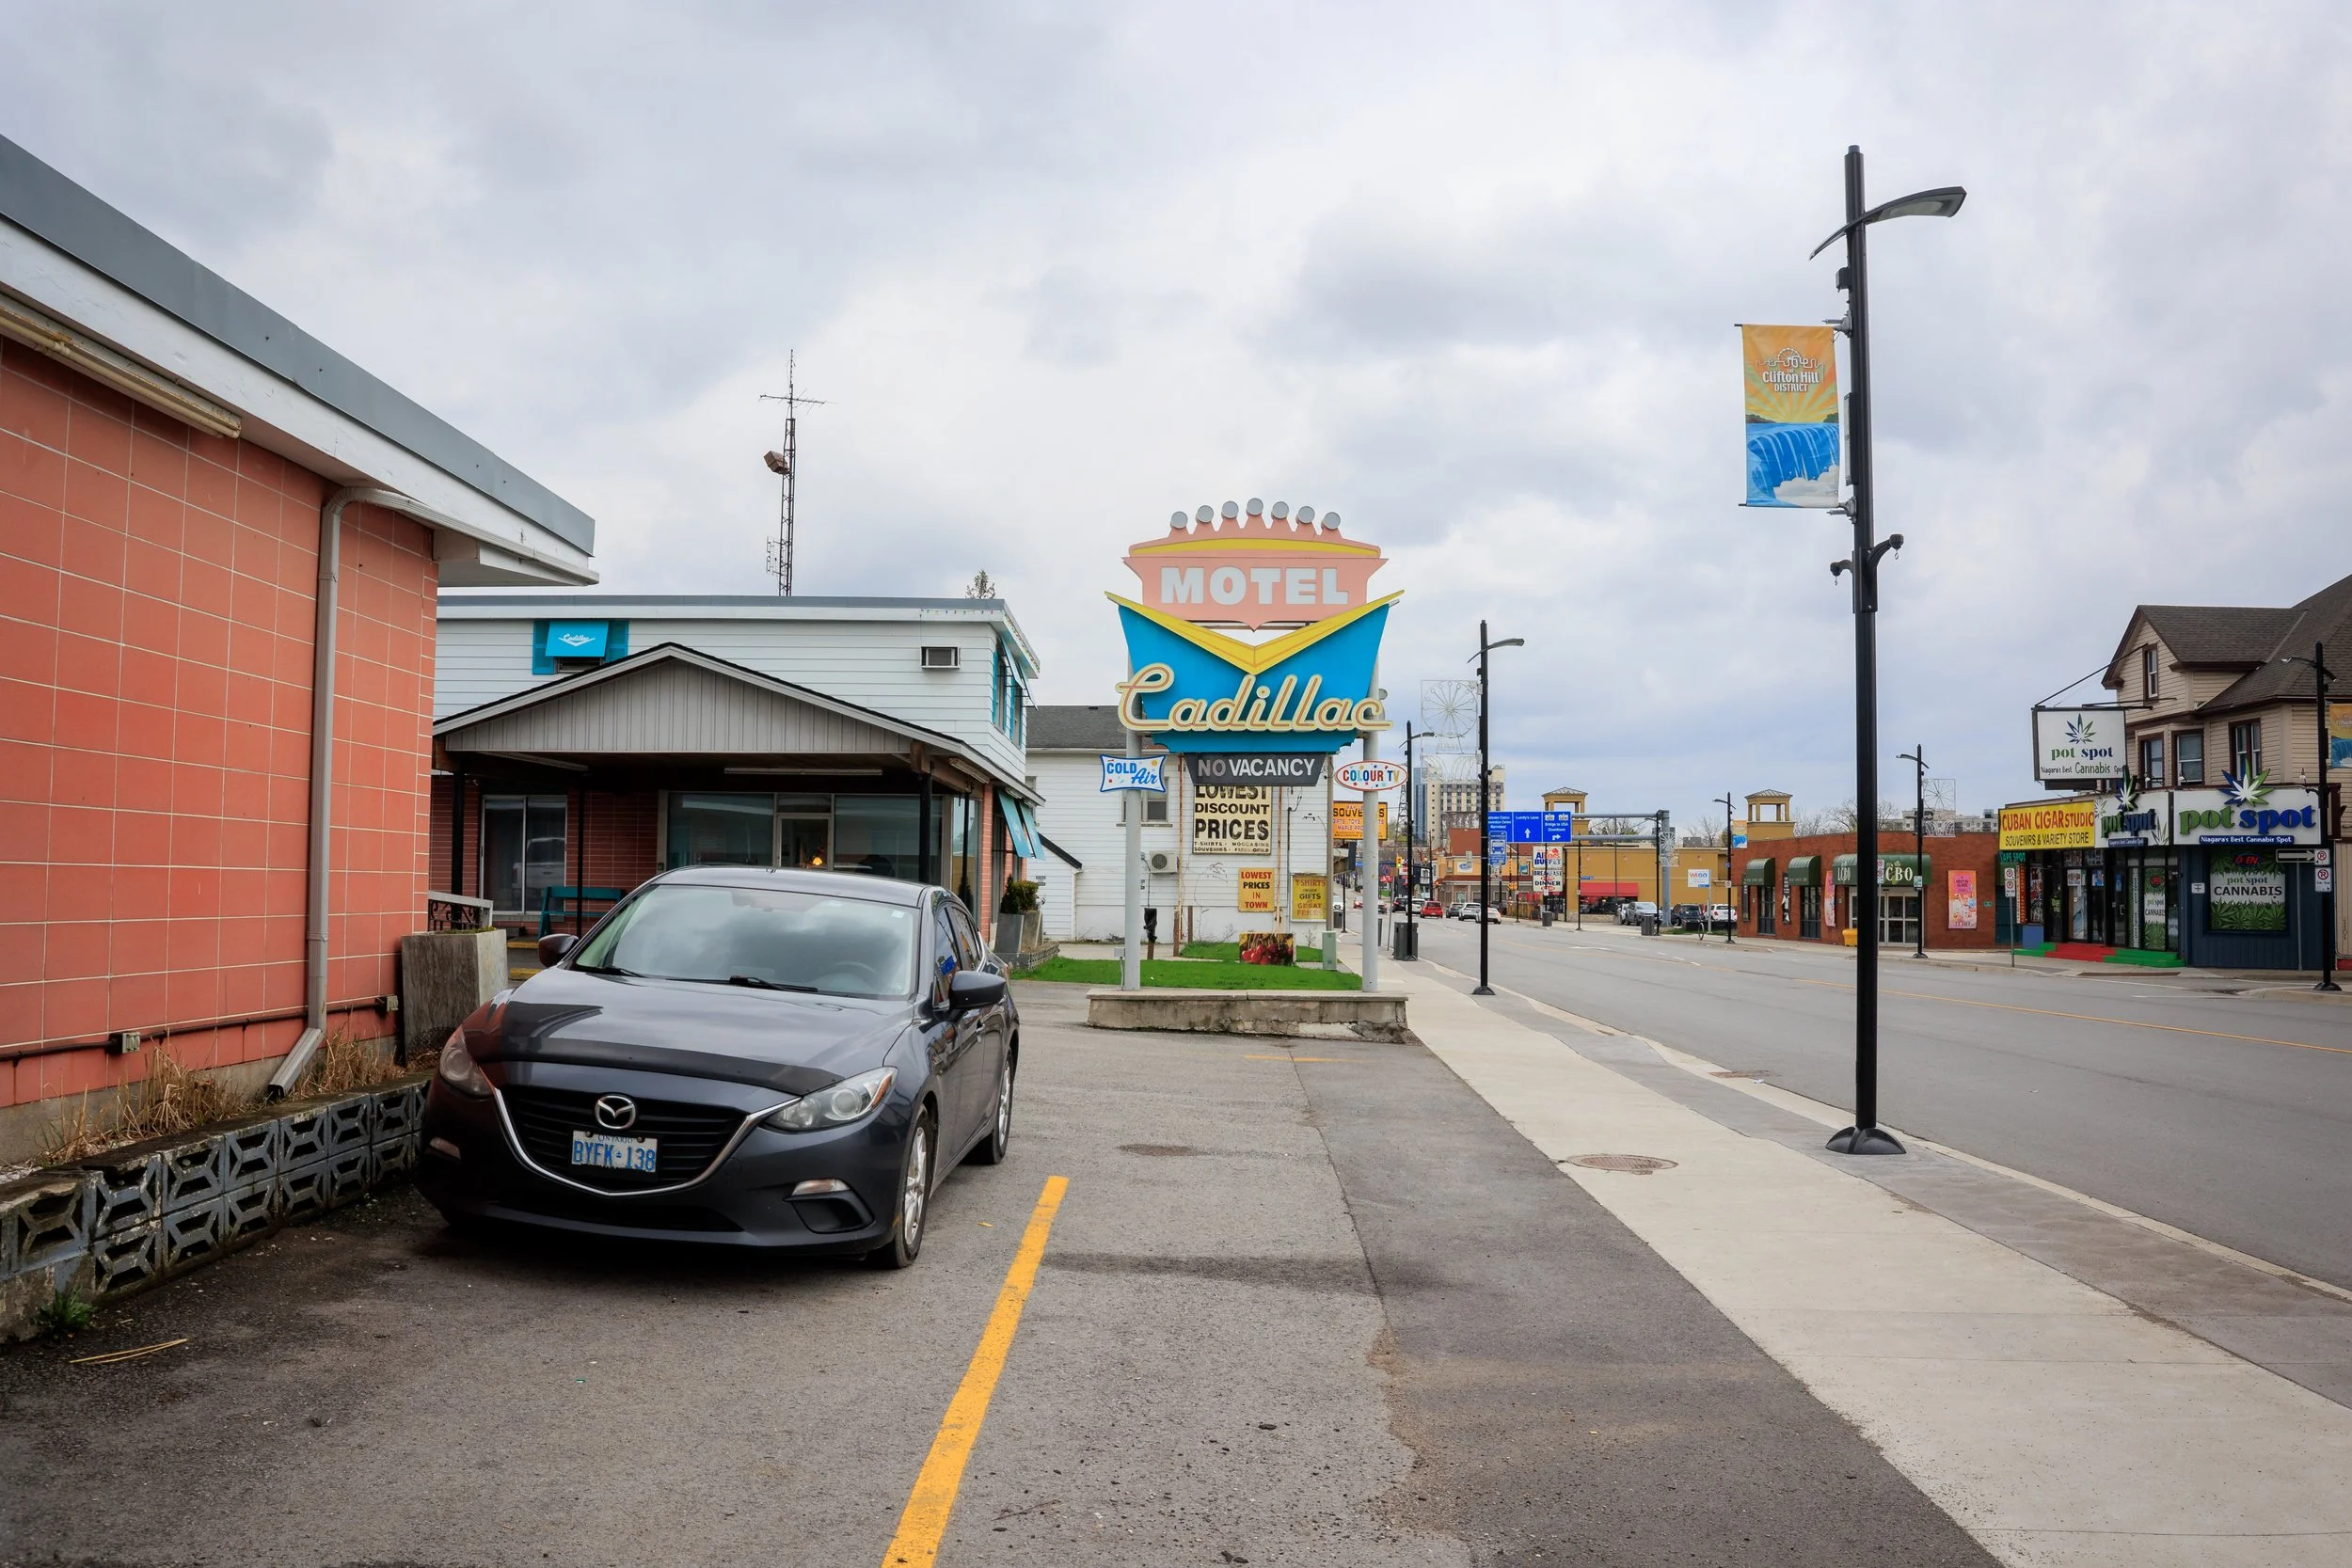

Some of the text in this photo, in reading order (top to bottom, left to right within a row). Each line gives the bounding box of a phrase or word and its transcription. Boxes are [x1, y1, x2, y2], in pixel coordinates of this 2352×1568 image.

[1762, 371, 1819, 383] Clifton Hill
[1774, 383, 1807, 392] DISTRICT
[1160, 566, 1348, 606] MOTEL
[1115, 662, 1393, 732] Cadillac
[2051, 747, 2114, 761] pot spot
[1106, 762, 1137, 774] COLD
[1198, 758, 1315, 777] NO VACANCY
[2074, 761, 2110, 774] Cannabis
[2113, 765, 2123, 774] Spo
[1131, 767, 1158, 784] Air
[1343, 769, 1400, 782] COLOUR TV
[1195, 785, 1267, 800] LOWEST
[1195, 802, 1270, 815] DISCOUNT
[1333, 808, 1385, 817] SOUVES
[2002, 810, 2095, 832] CUBAN CIGAR STUDIO
[2179, 805, 2316, 835] pot spot
[1195, 818, 1269, 841] PRICES
[2037, 834, 2042, 845] &
[2042, 832, 2067, 845] VARIETY
[2068, 832, 2089, 844] STORE
[2013, 851, 2026, 862] SPOT
[1241, 871, 1272, 879] LOWEST
[1837, 867, 1851, 881] LCBO
[1885, 867, 1913, 881] CBO
[1243, 881, 1270, 890] PRICES
[2246, 877, 2268, 885] spot
[2214, 886, 2282, 896] CANNABIS
[597, 1134, 633, 1144] ONTARIO
[573, 1141, 656, 1171] BYFK 138
